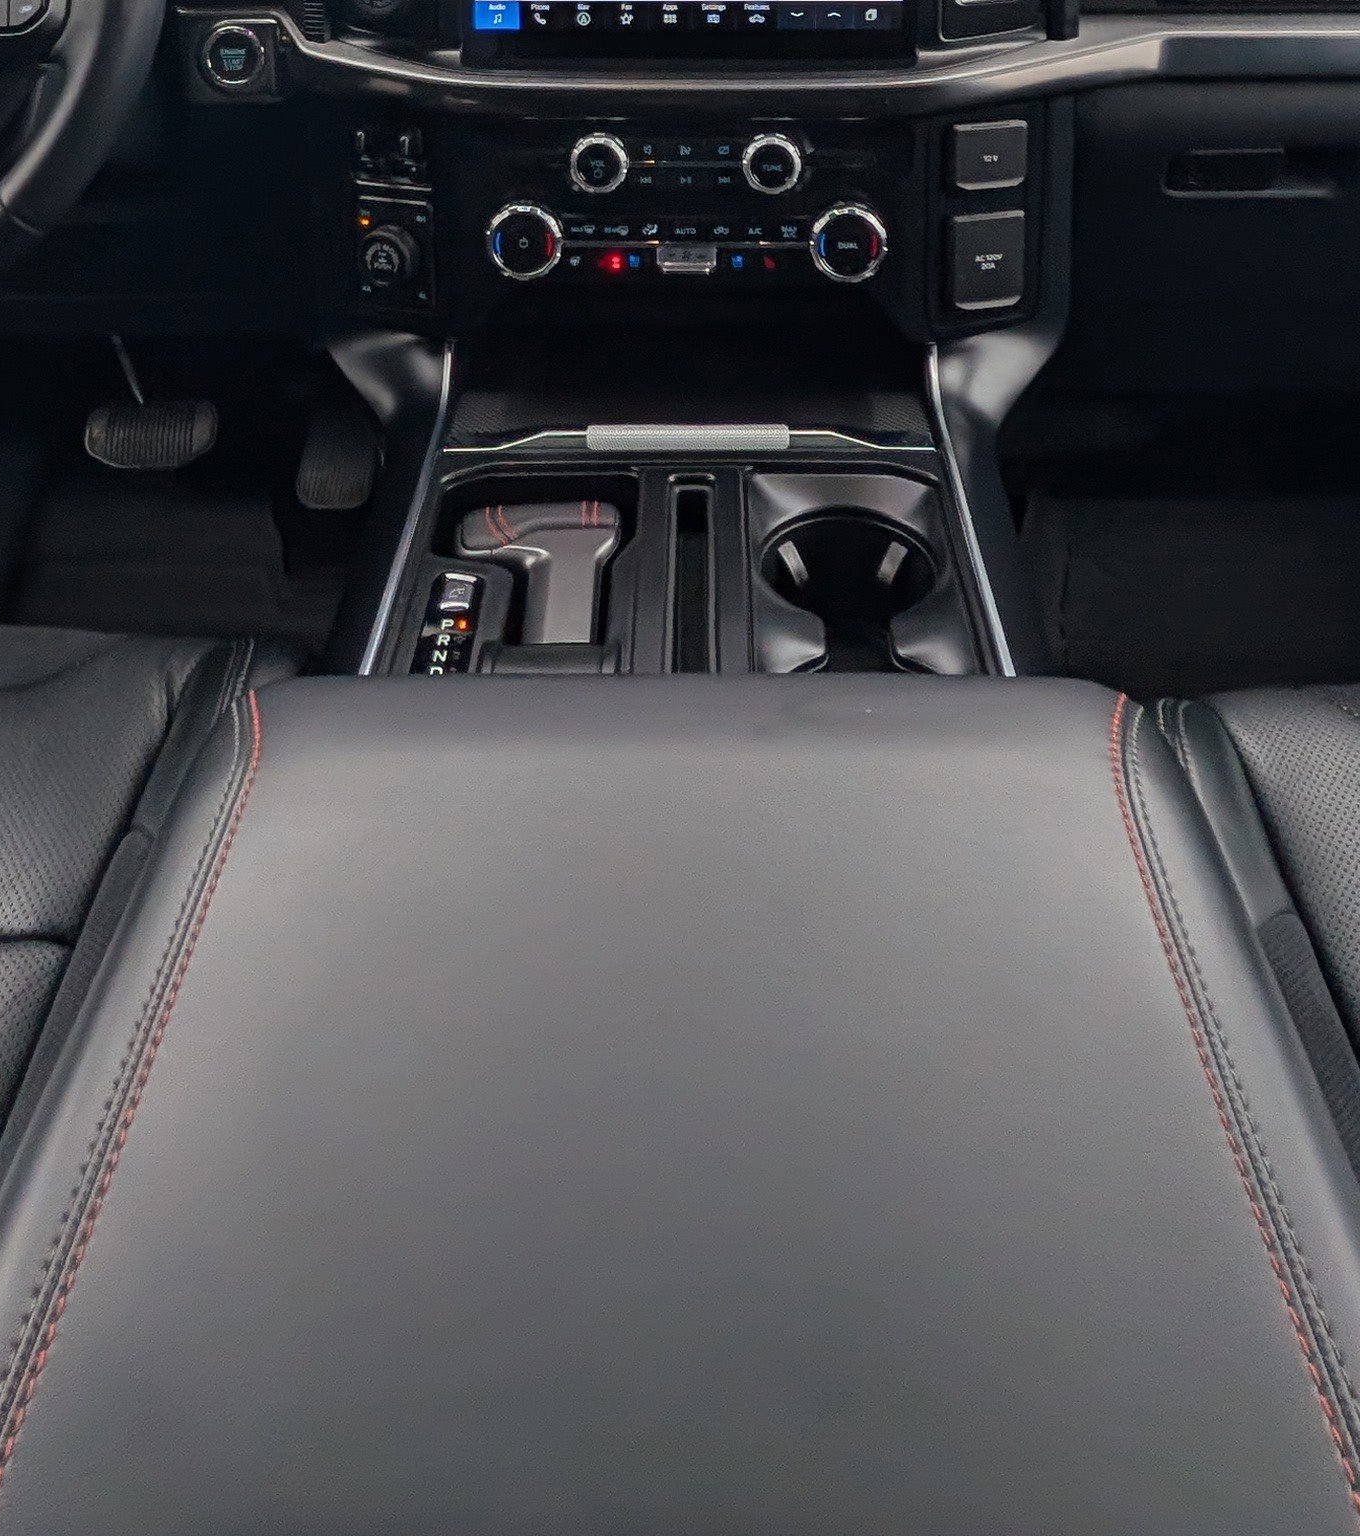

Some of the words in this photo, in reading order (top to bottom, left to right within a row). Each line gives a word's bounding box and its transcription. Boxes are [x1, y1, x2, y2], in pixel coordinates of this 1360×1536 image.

[441, 618, 455, 631] P
[437, 634, 451, 646] R
[433, 650, 448, 662] N
